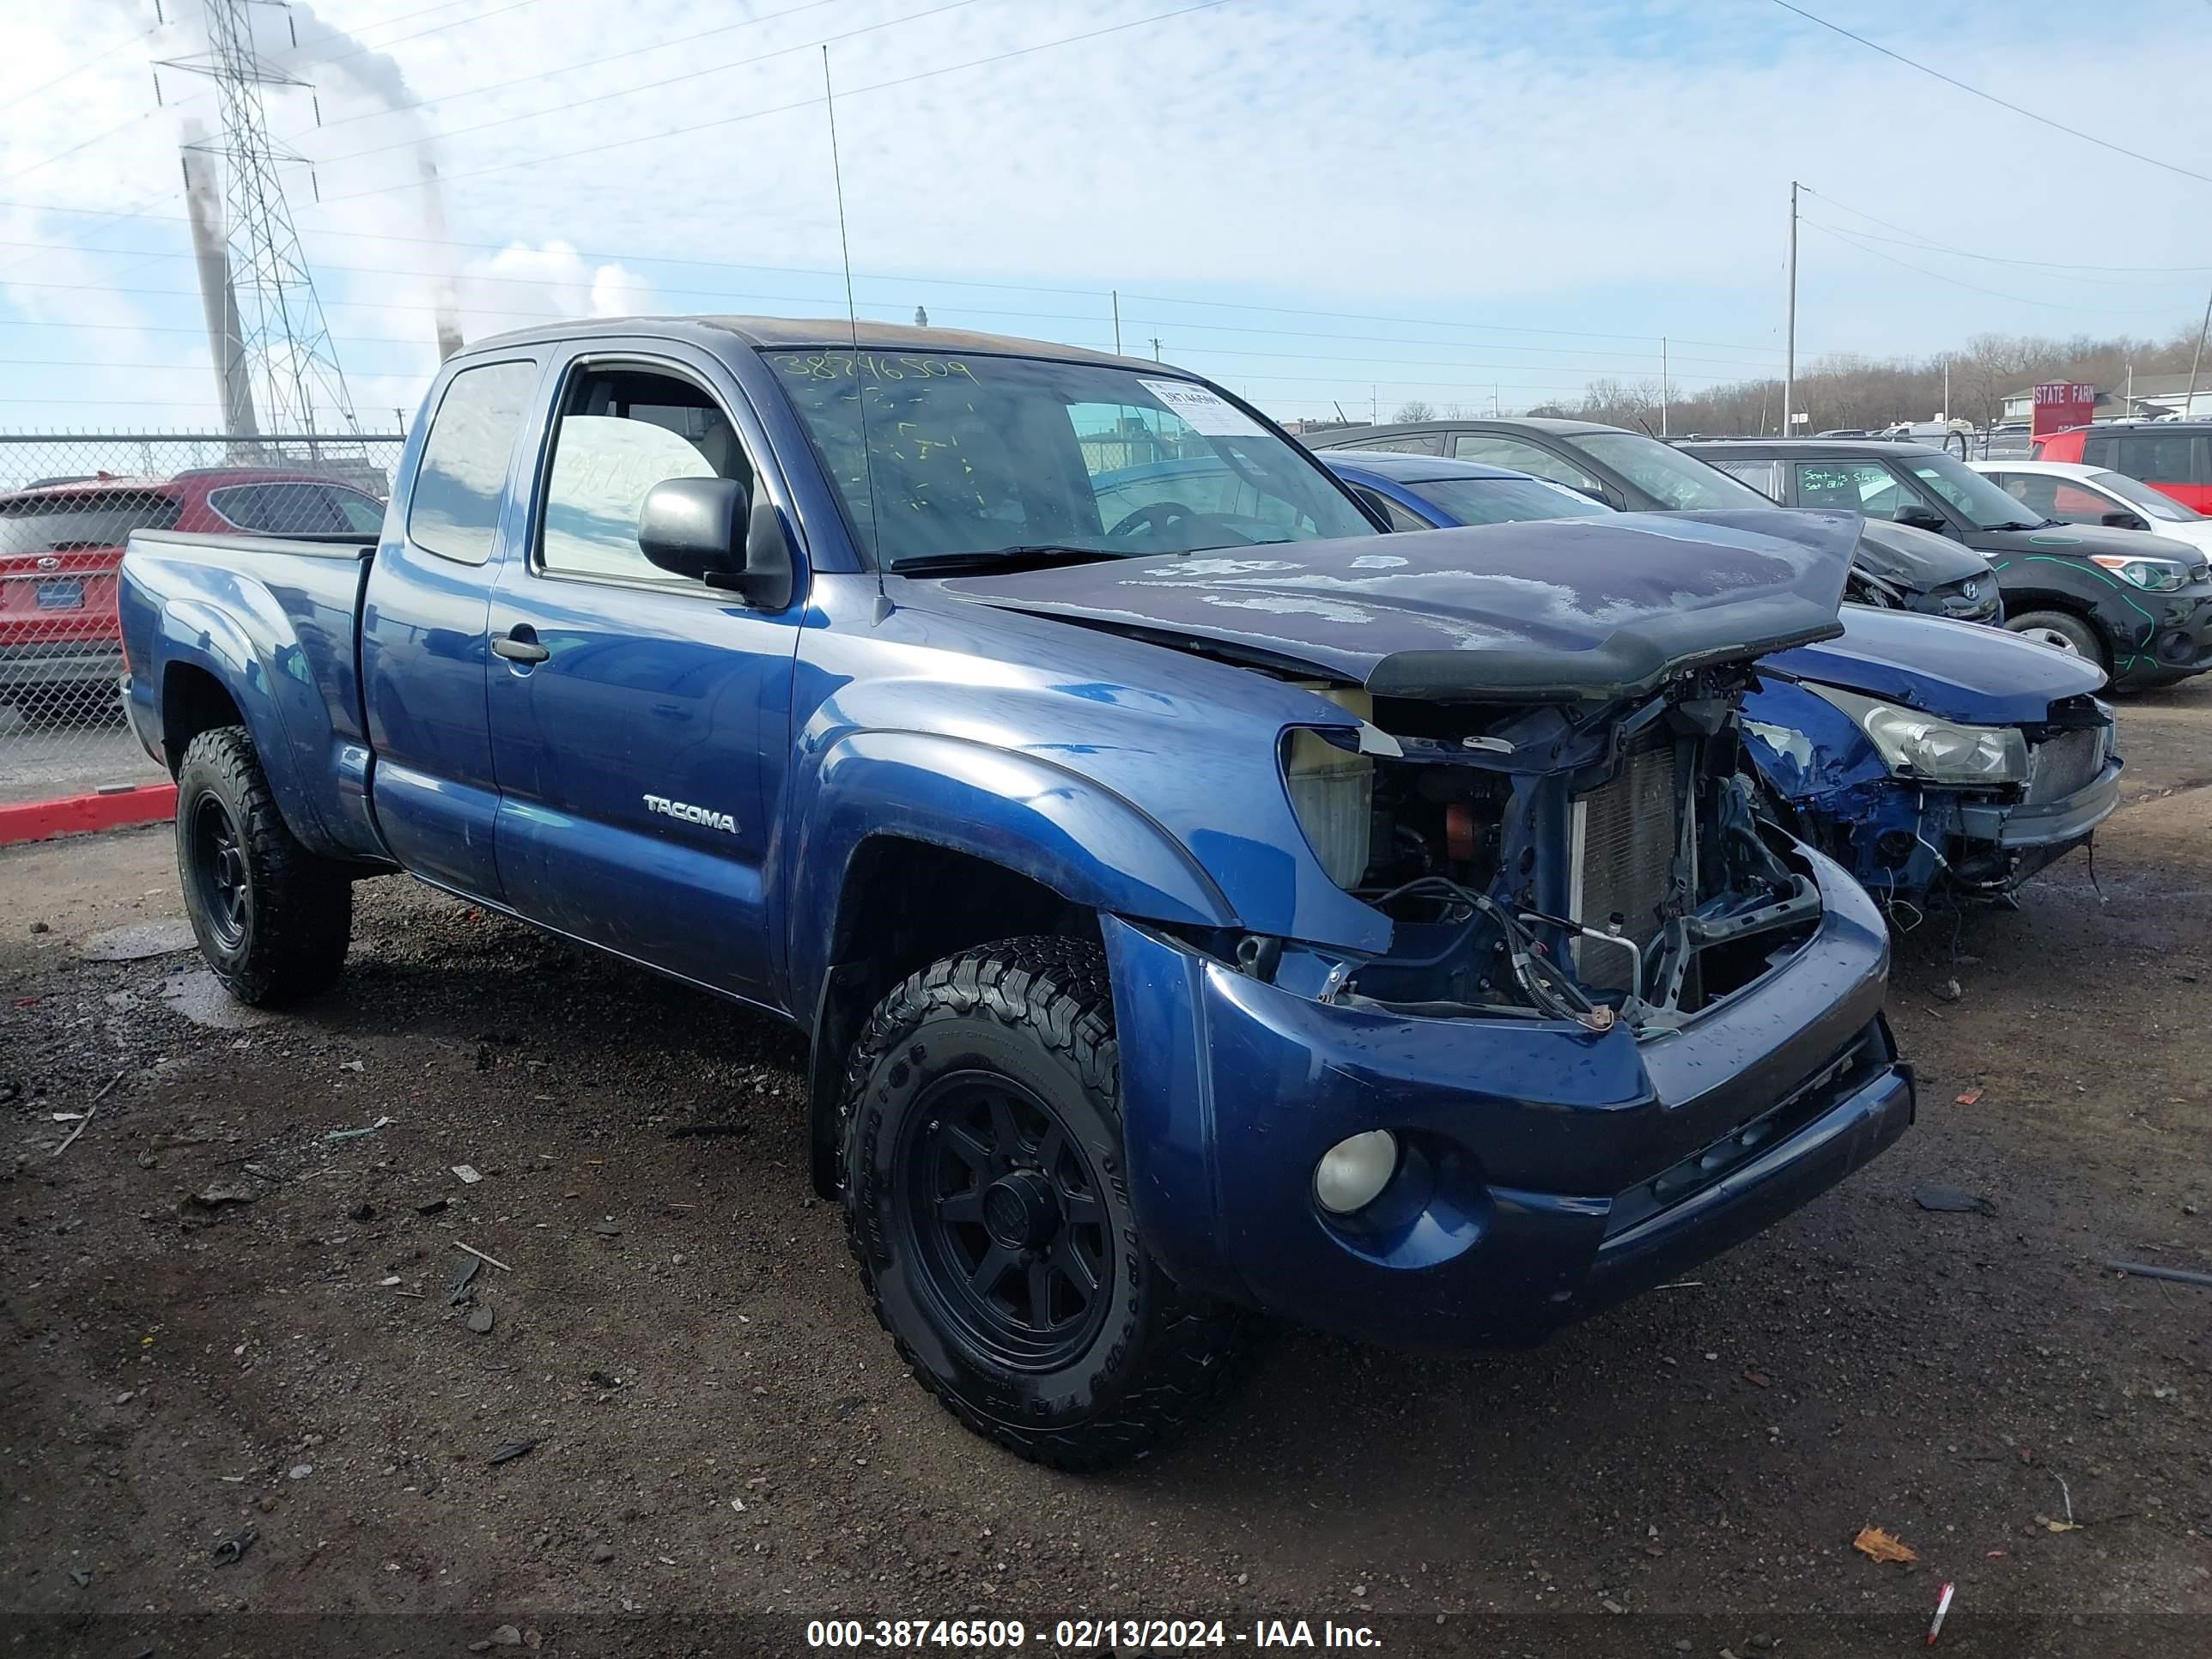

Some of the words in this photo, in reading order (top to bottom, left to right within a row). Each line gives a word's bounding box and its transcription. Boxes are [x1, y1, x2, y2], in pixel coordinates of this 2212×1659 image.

[773, 353, 981, 386] 38746509
[2035, 385, 2065, 404] STATE
[642, 794, 742, 836] TACOMA
